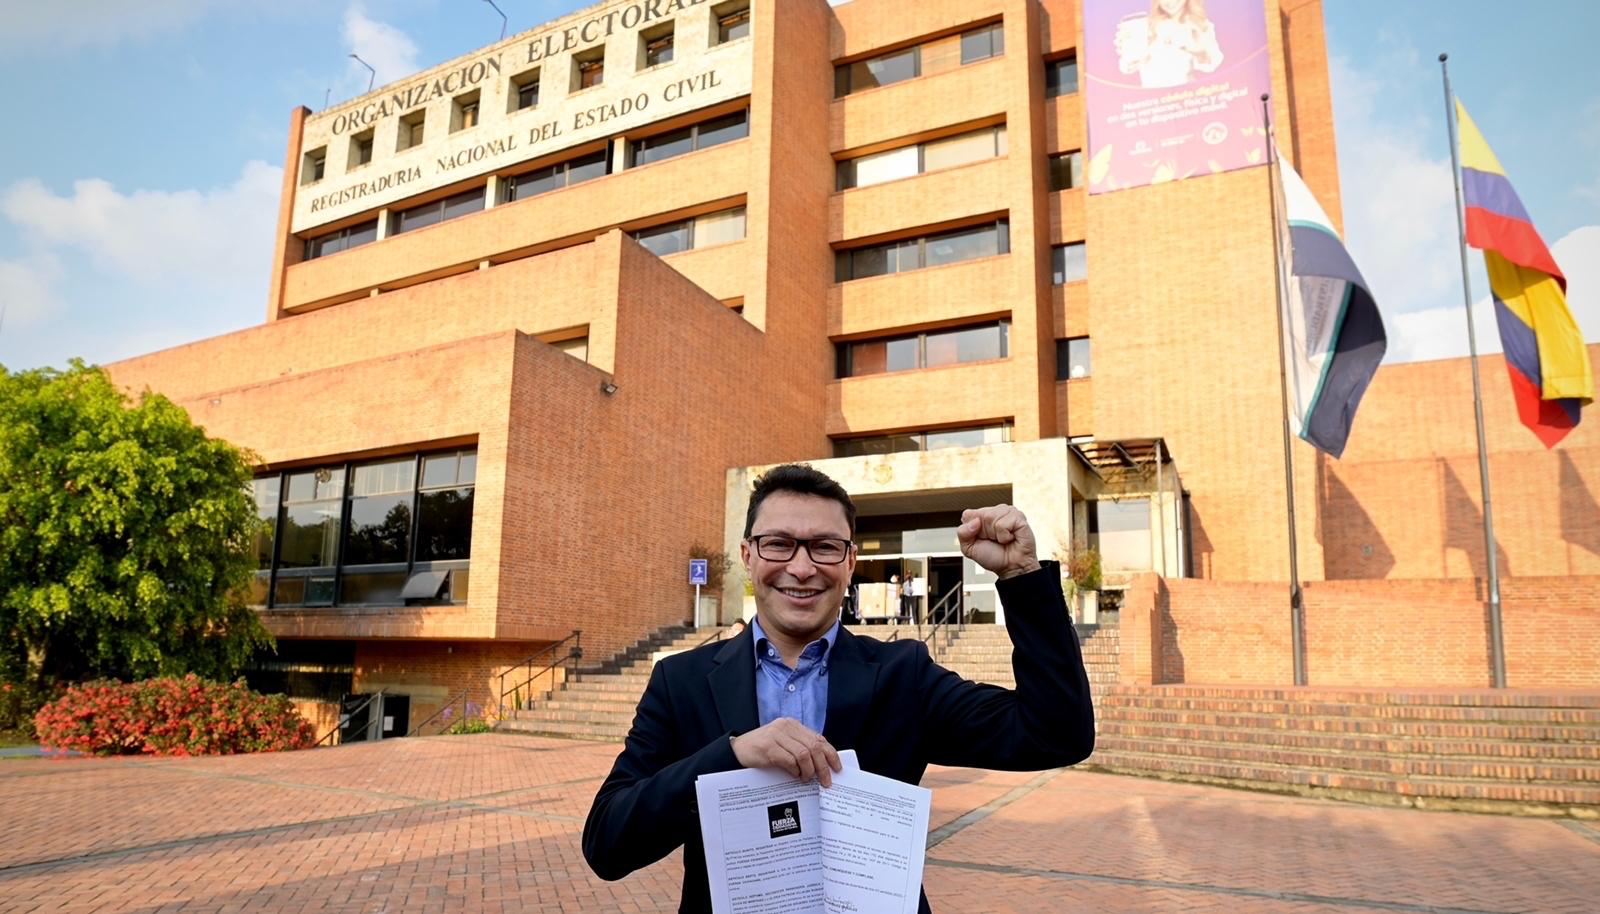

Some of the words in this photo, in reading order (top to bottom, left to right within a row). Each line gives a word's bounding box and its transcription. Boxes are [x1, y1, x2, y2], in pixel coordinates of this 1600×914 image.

[332, 53, 503, 135] ORGANIZACION
[527, 0, 706, 63] ELECTORA
[1196, 82, 1230, 97] digital
[1218, 87, 1248, 101] digital
[311, 165, 421, 213] REGISTRADURIA
[436, 135, 518, 174] NACIONAL
[529, 121, 562, 145] DEL
[573, 93, 649, 130] ESTADO
[663, 70, 722, 102] CIVIL
[772, 817, 795, 827] FUERZA
